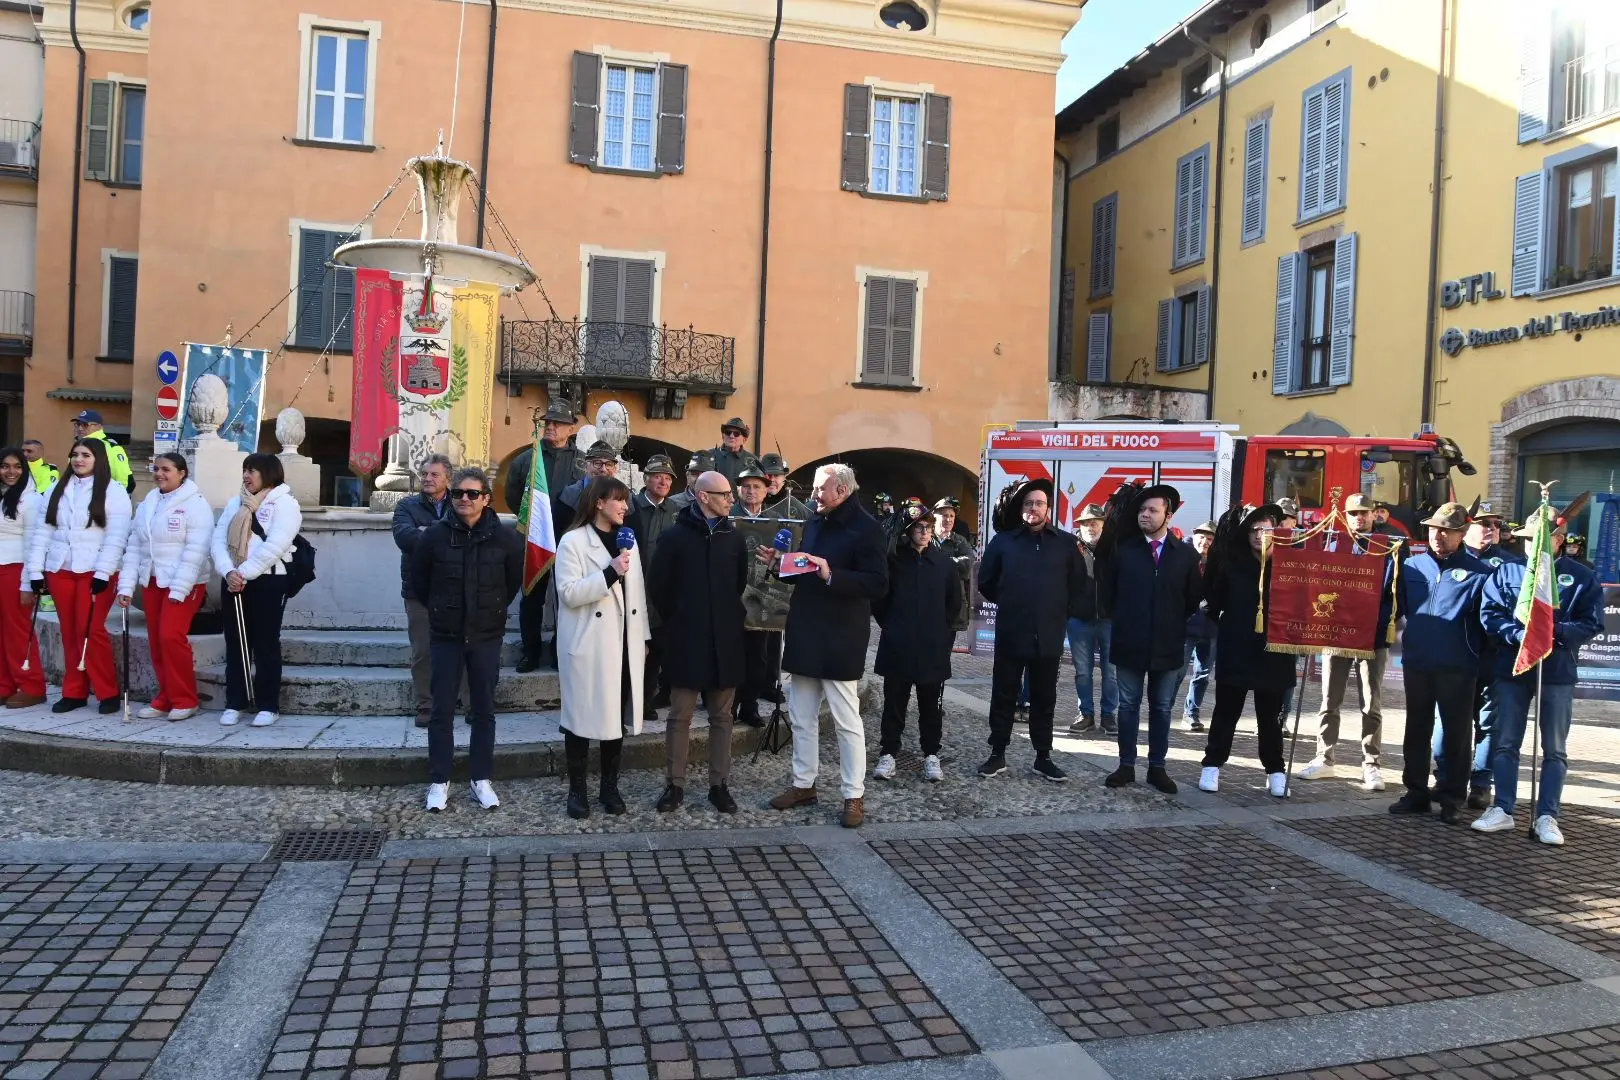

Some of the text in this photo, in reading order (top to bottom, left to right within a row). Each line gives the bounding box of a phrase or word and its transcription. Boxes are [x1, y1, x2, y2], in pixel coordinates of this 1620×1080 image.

[1440, 271, 1504, 310] BTL
[1467, 326, 1520, 348] Banca
[1523, 314, 1555, 339] del
[160, 421, 169, 429] 20
[1041, 434, 1160, 447] VIGILI DEL FUOCO
[1286, 622, 1339, 633] PALAZZOLO
